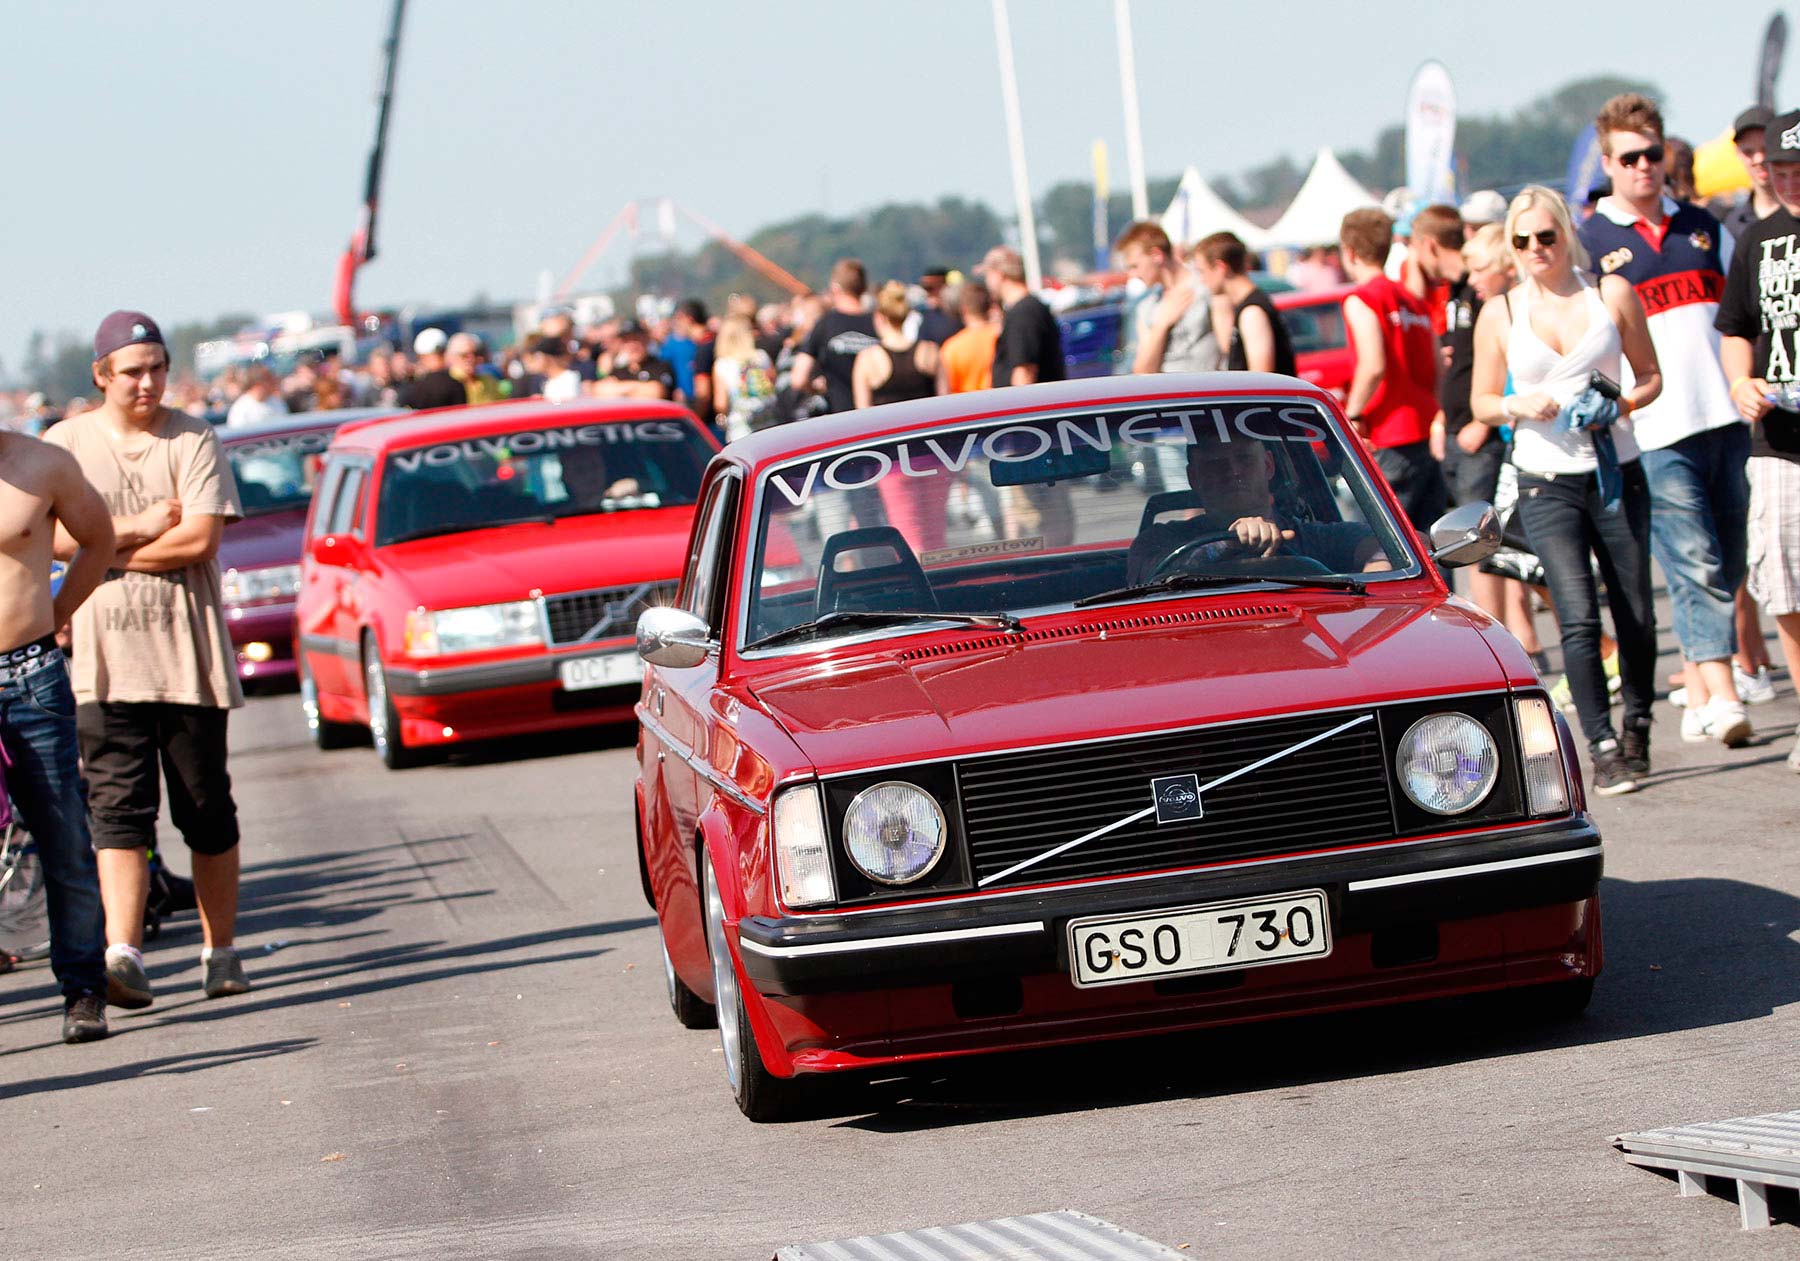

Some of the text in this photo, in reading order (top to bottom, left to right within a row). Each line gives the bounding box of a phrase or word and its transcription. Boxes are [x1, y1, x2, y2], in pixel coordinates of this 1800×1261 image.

[394, 422, 685, 473] VOLVONETICS
[770, 407, 1326, 506] VOLVONETICS
[122, 583, 176, 609] YOU
[1084, 905, 1315, 974] GSO 730
